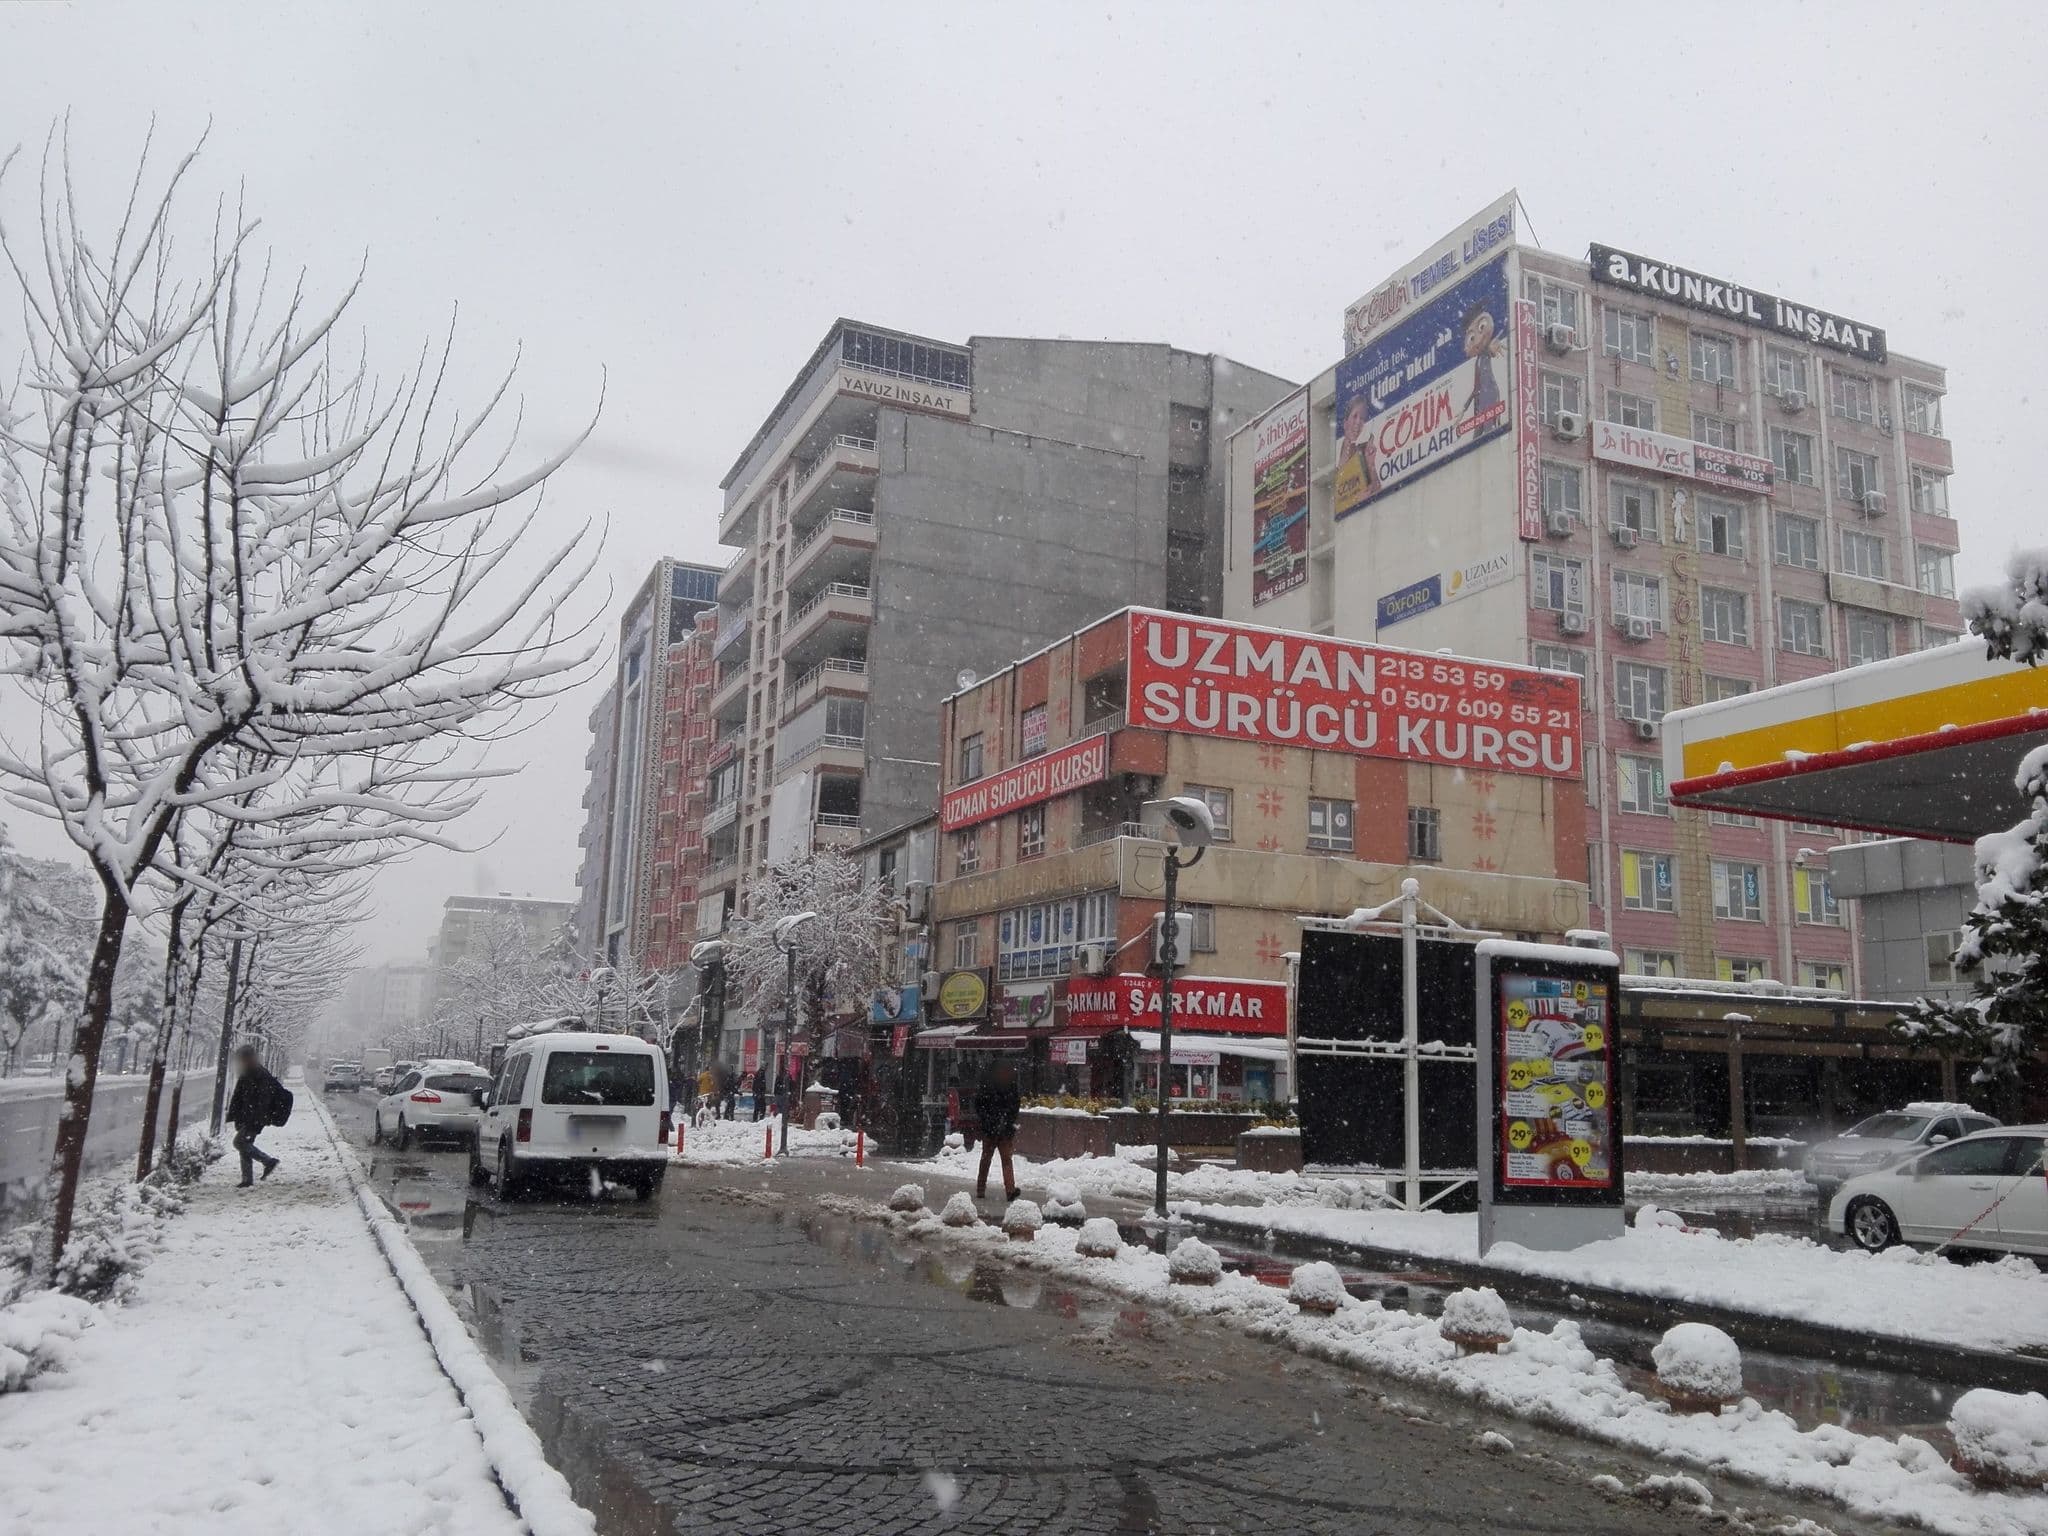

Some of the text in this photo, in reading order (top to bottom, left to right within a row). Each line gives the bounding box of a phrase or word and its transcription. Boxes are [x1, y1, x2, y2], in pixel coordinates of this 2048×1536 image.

[1410, 250, 1460, 300] TEMEL
[1775, 298, 1873, 352] İNŞAAT
[1406, 345, 1436, 382] okul
[843, 376, 953, 411] YAVUZ İNŞAAT
[1379, 388, 1453, 459] ÇÖZÜM
[1523, 332, 1540, 536] İHTİYAÇ AKADEMİ
[1698, 448, 1769, 473] KPSS ÖABT
[1704, 461, 1765, 482] DGS YDS
[1464, 553, 1510, 582] UZMAN
[1570, 568, 1578, 596] YDS
[1386, 587, 1430, 617] OXFORD
[1147, 621, 1376, 696] UZMAN
[1380, 657, 1506, 691] 213 53 59
[1143, 677, 1573, 773] SÜRÜCÜ KURSU
[1381, 687, 1570, 729] 0 507 609 55 21
[946, 787, 988, 825] UZMAN
[990, 760, 1047, 810] SÜRÜCÜ
[1050, 744, 1104, 787] KURSU
[1067, 990, 1117, 1016] ŞARKMAR
[1129, 988, 1264, 1020] ŞARKMAR
